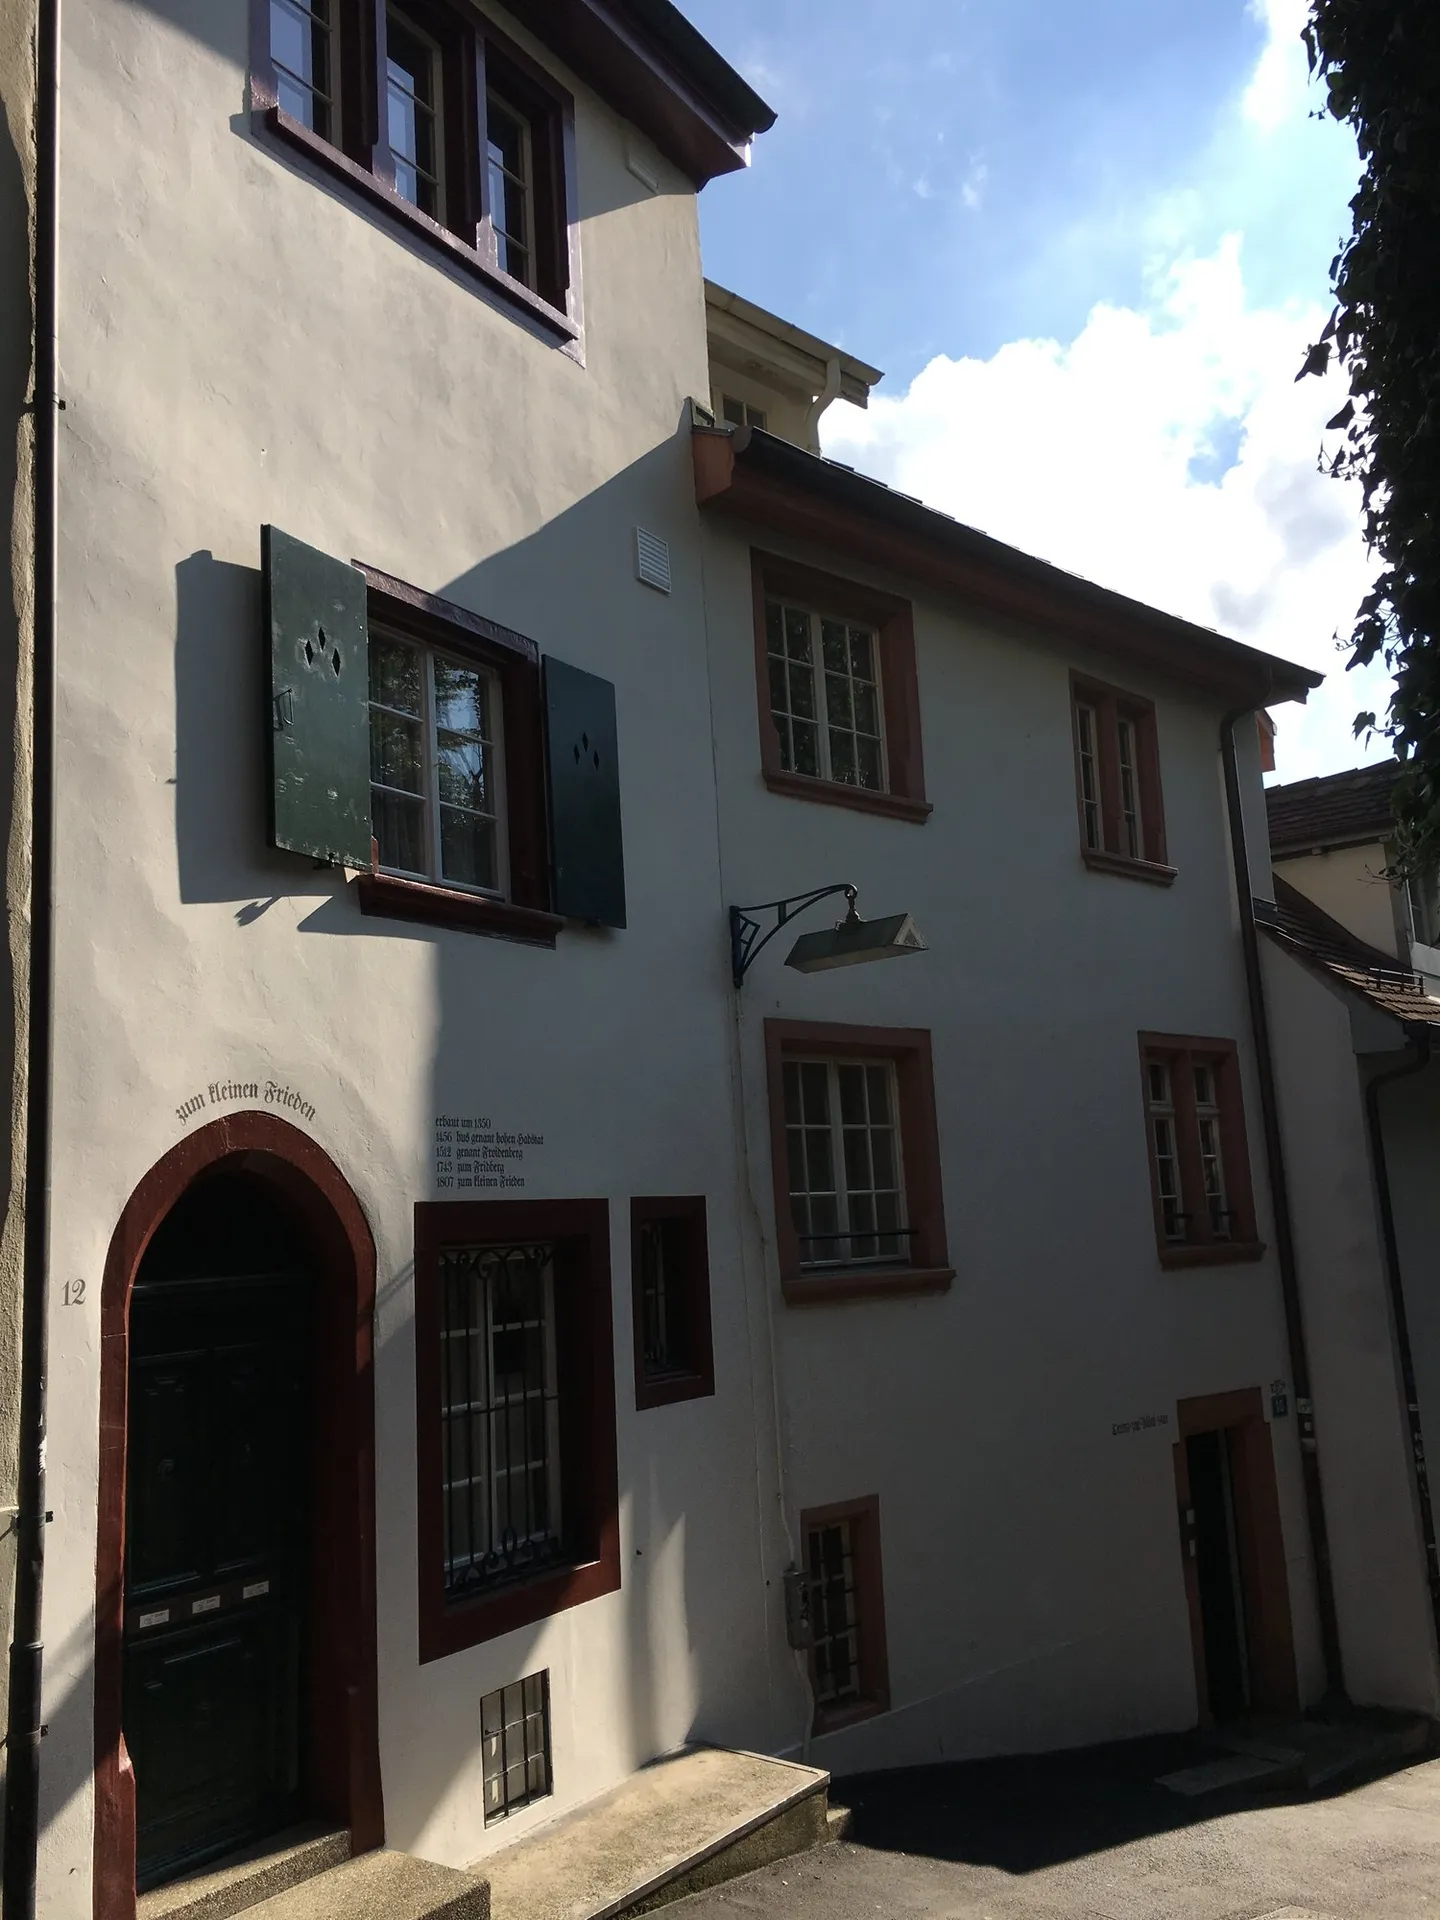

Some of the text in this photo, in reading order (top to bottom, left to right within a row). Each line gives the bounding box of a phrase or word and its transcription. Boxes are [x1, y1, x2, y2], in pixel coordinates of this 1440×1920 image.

[175, 1080, 317, 1126] zum kleinen Frieden
[461, 1118, 473, 1129] um
[436, 1146, 452, 1157] 1512
[437, 1176, 454, 1188] 1807
[61, 1278, 86, 1306] 12
